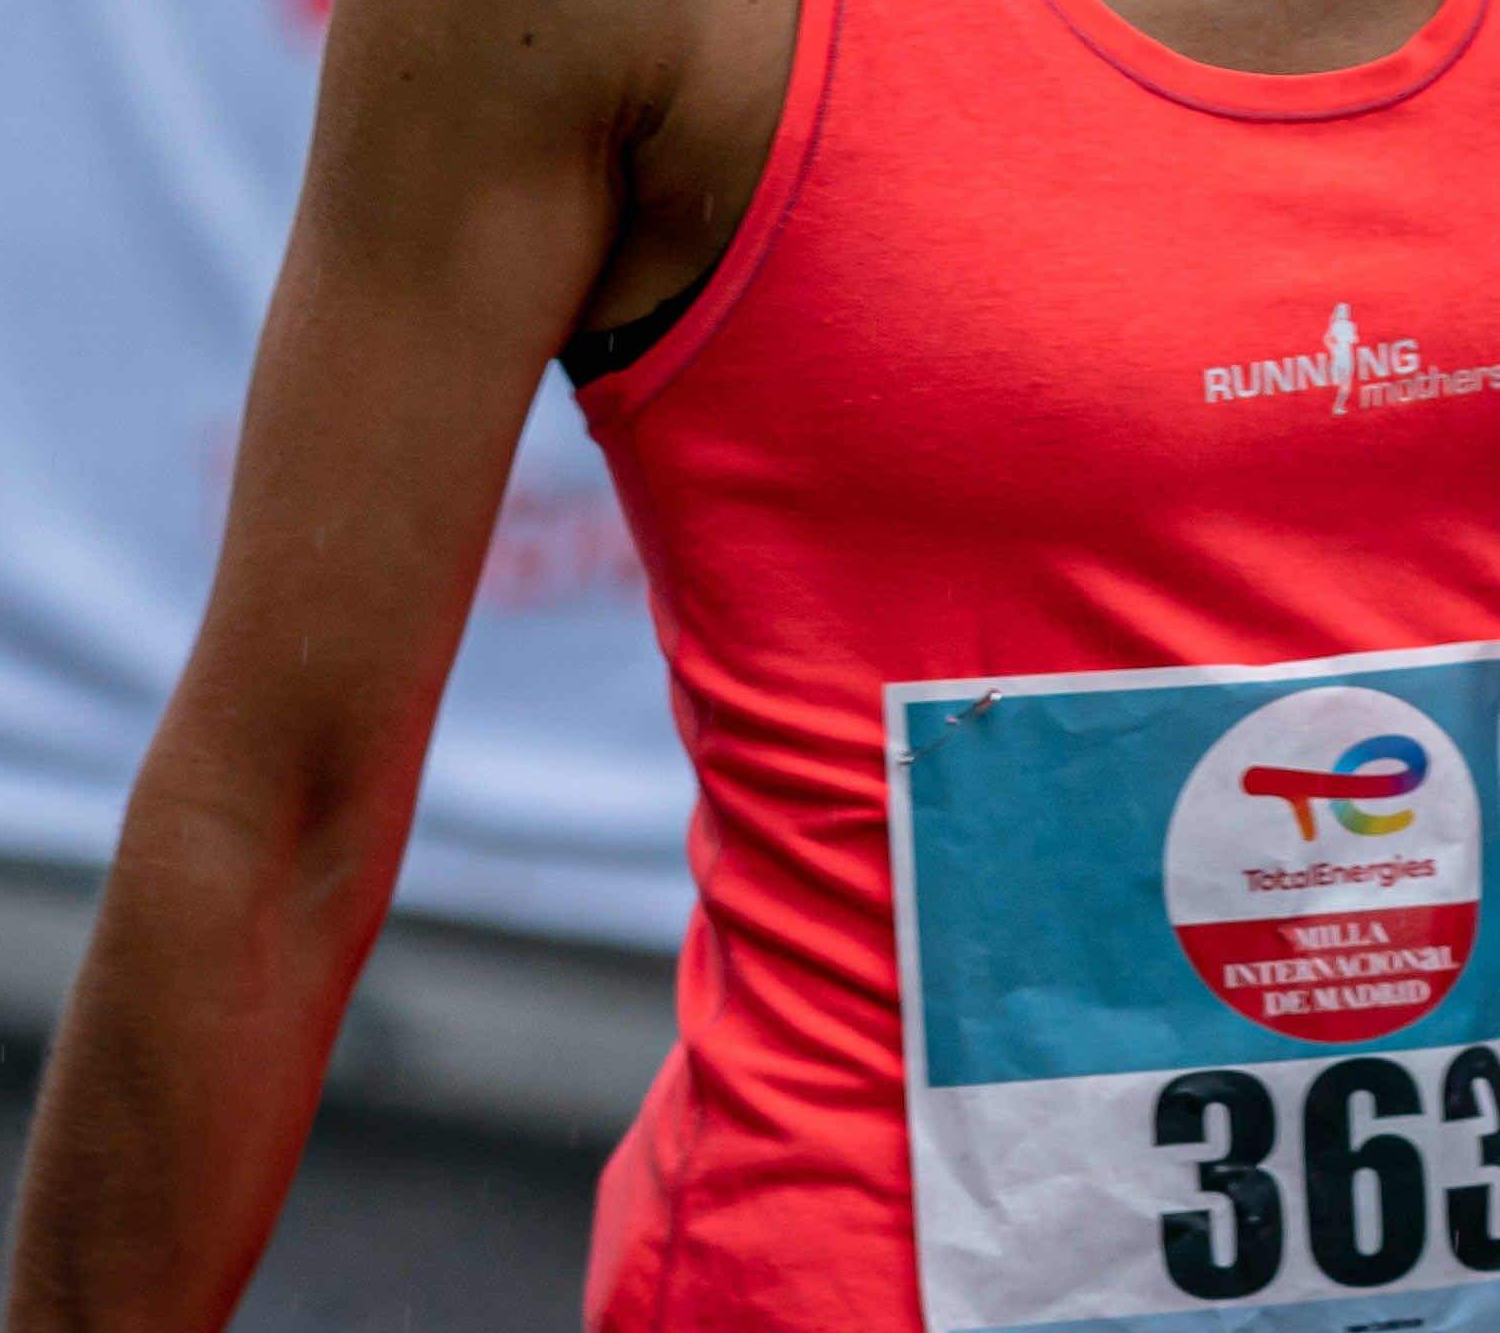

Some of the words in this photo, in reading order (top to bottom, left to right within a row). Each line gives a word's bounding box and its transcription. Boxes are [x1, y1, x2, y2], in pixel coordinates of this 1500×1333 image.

[1242, 854, 1438, 893] TotalEnergies
[1278, 921, 1391, 952] MILLA
[1222, 945, 1461, 989] INTERNACIONAL
[1262, 989, 1311, 1017] DE
[1312, 979, 1432, 1012] MADRID
